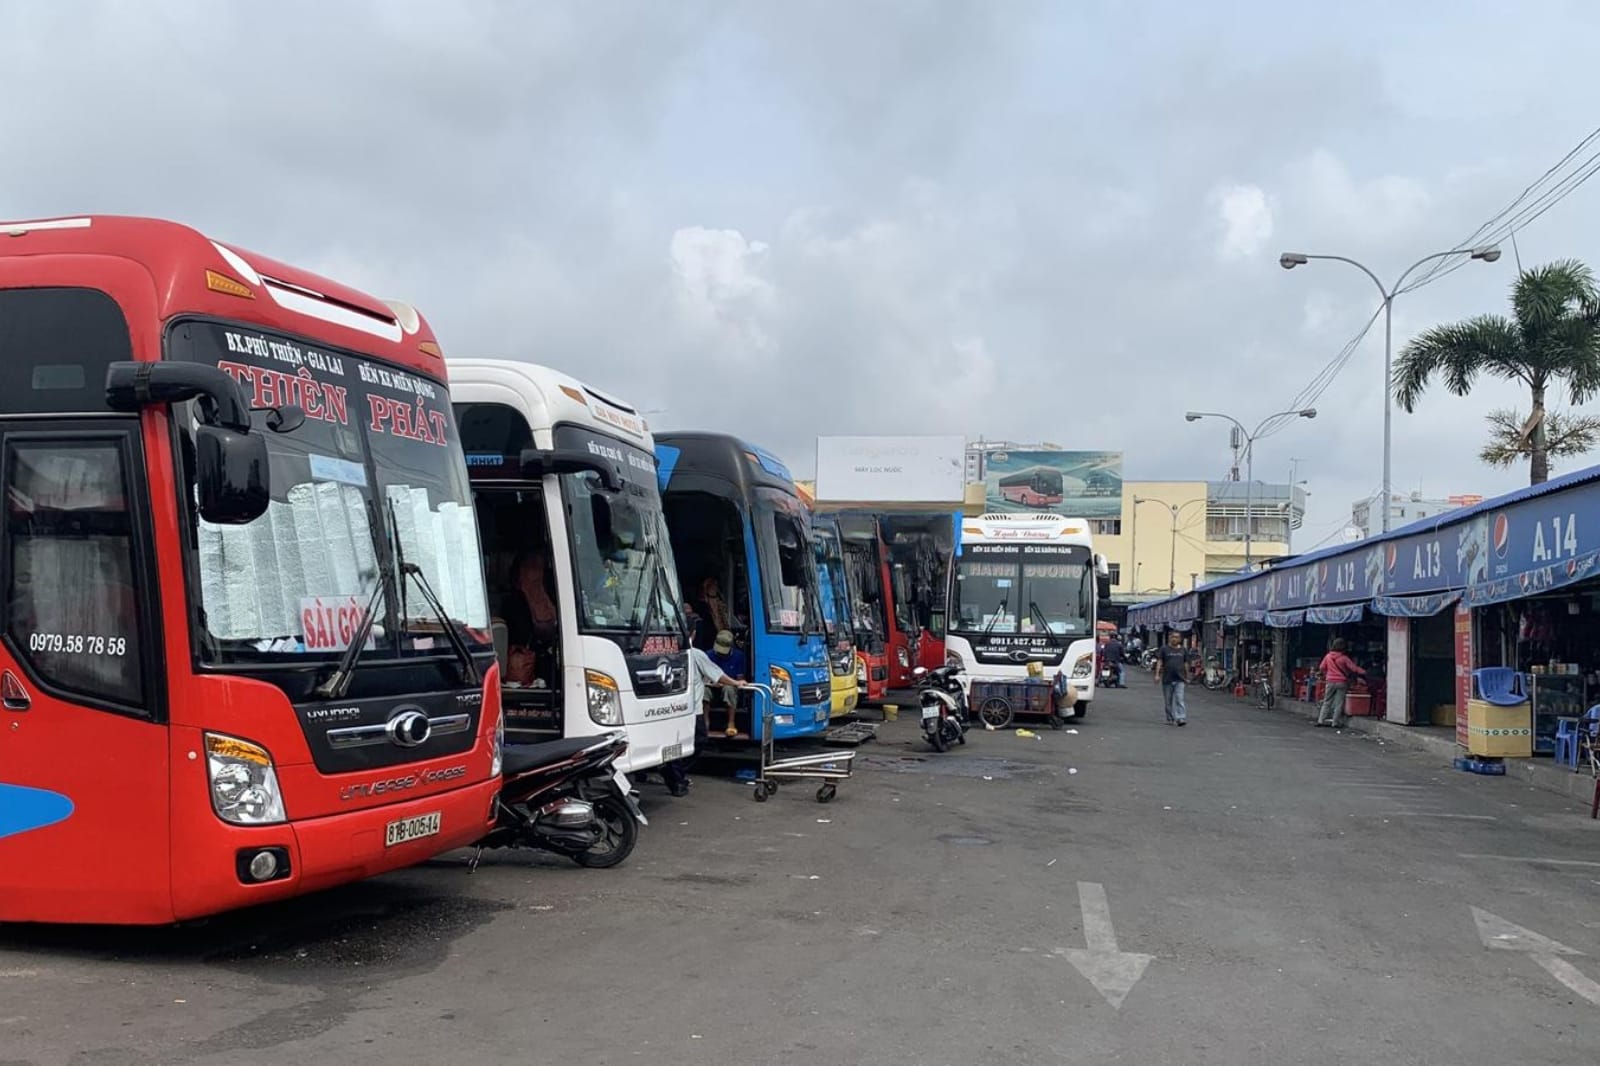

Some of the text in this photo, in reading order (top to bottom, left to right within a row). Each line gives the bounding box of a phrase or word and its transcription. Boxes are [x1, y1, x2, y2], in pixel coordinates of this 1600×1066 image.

[307, 351, 327, 372] GIA
[326, 356, 344, 376] LAI
[378, 369, 392, 387] XE
[366, 393, 448, 446] PHÁT
[1532, 514, 1578, 562] A.14
[1336, 561, 1355, 592] A.12
[1413, 541, 1441, 579] A.13
[303, 597, 337, 648] SÀI
[30, 633, 126, 656] 0979.58 78 58
